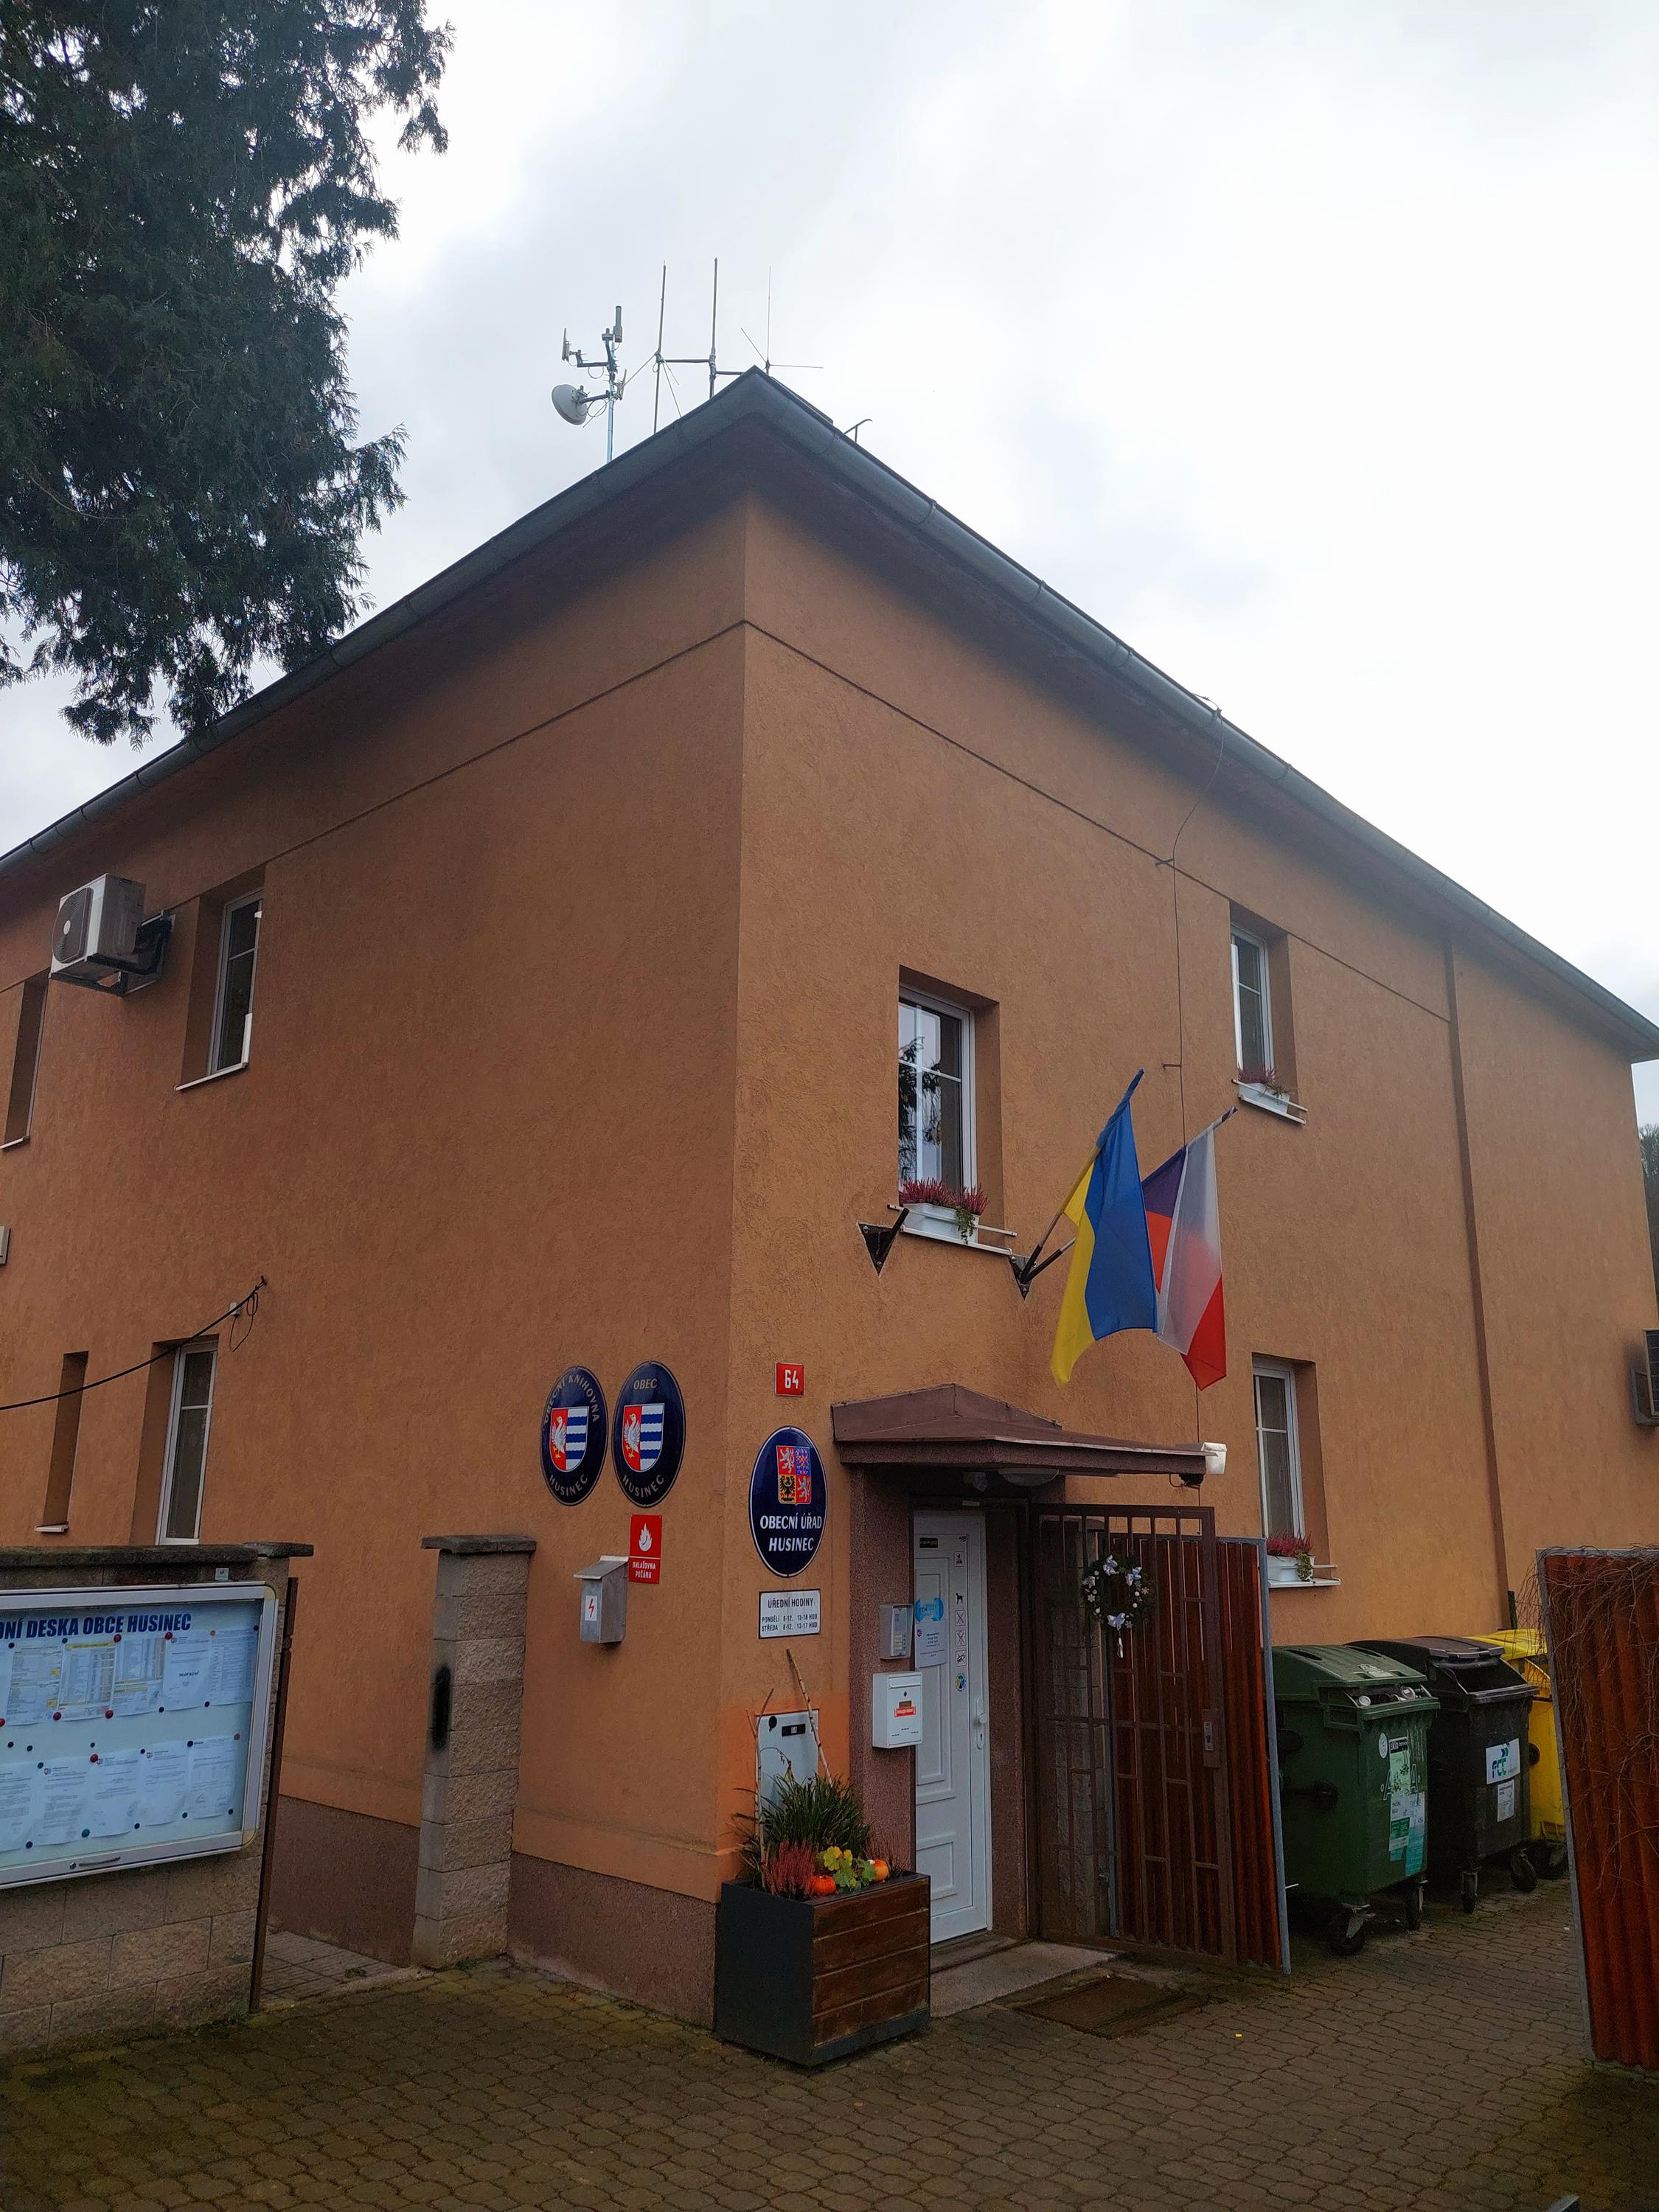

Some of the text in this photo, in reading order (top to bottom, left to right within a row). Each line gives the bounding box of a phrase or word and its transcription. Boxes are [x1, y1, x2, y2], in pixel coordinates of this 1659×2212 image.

[633, 1378, 658, 1390] OBEC
[784, 1369, 799, 1389] 64
[544, 1374, 600, 1423] OBECNÍ KNIHOVNA
[549, 1474, 588, 1497] HUSINEC
[622, 1474, 664, 1498] HUSINEC
[760, 1512, 822, 1530] OBECNÍ ÚŘAD
[768, 1537, 815, 1552] HUSINEC
[768, 1596, 790, 1608] ÚŘEDNÍ
[27, 1617, 79, 1638] DESKA
[83, 1615, 125, 1635] OBCE
[127, 1613, 192, 1632] HUSINEC
[762, 1624, 779, 1632] STŘEDA
[1492, 1757, 1506, 1779] FCC
